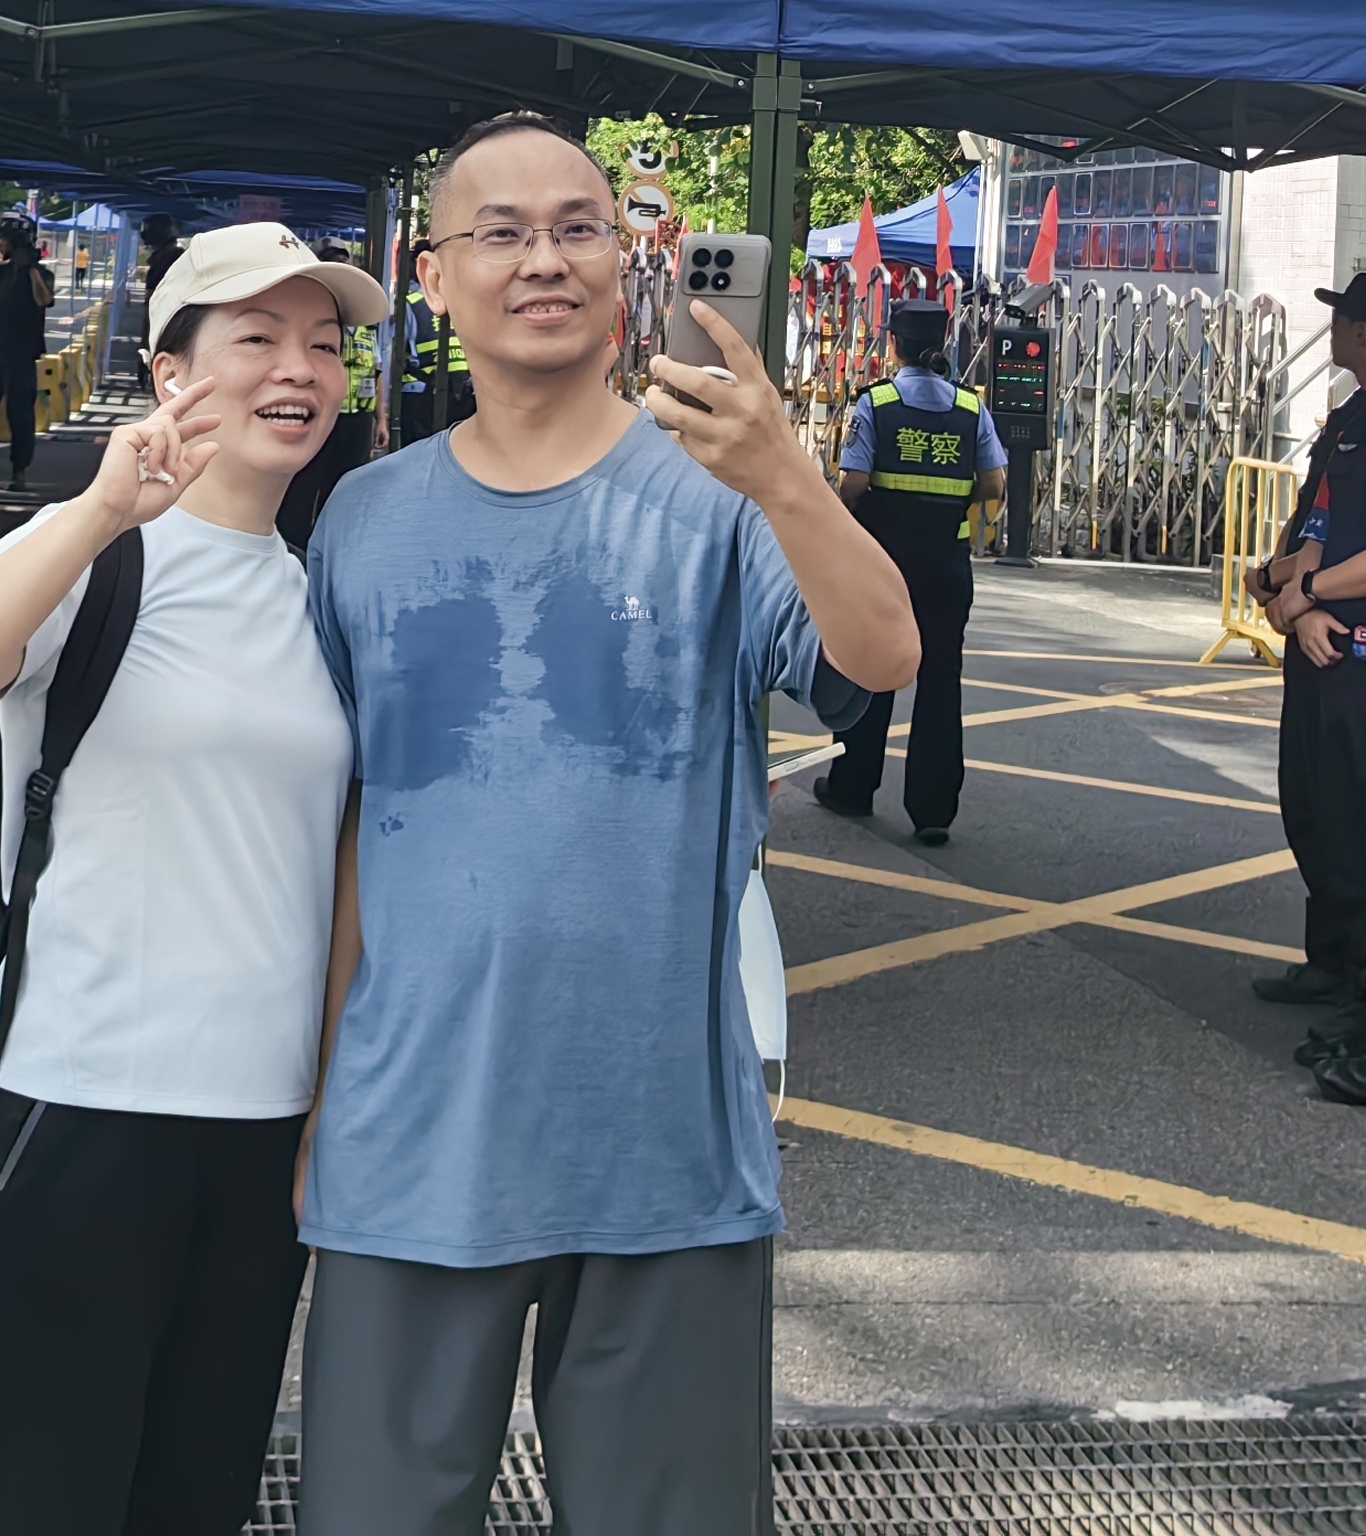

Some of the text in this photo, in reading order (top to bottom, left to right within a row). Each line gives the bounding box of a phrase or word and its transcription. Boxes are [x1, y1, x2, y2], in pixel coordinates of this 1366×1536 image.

[1002, 339, 1013, 356] P
[896, 427, 961, 465] 警察
[610, 609, 653, 621] CAMEL
